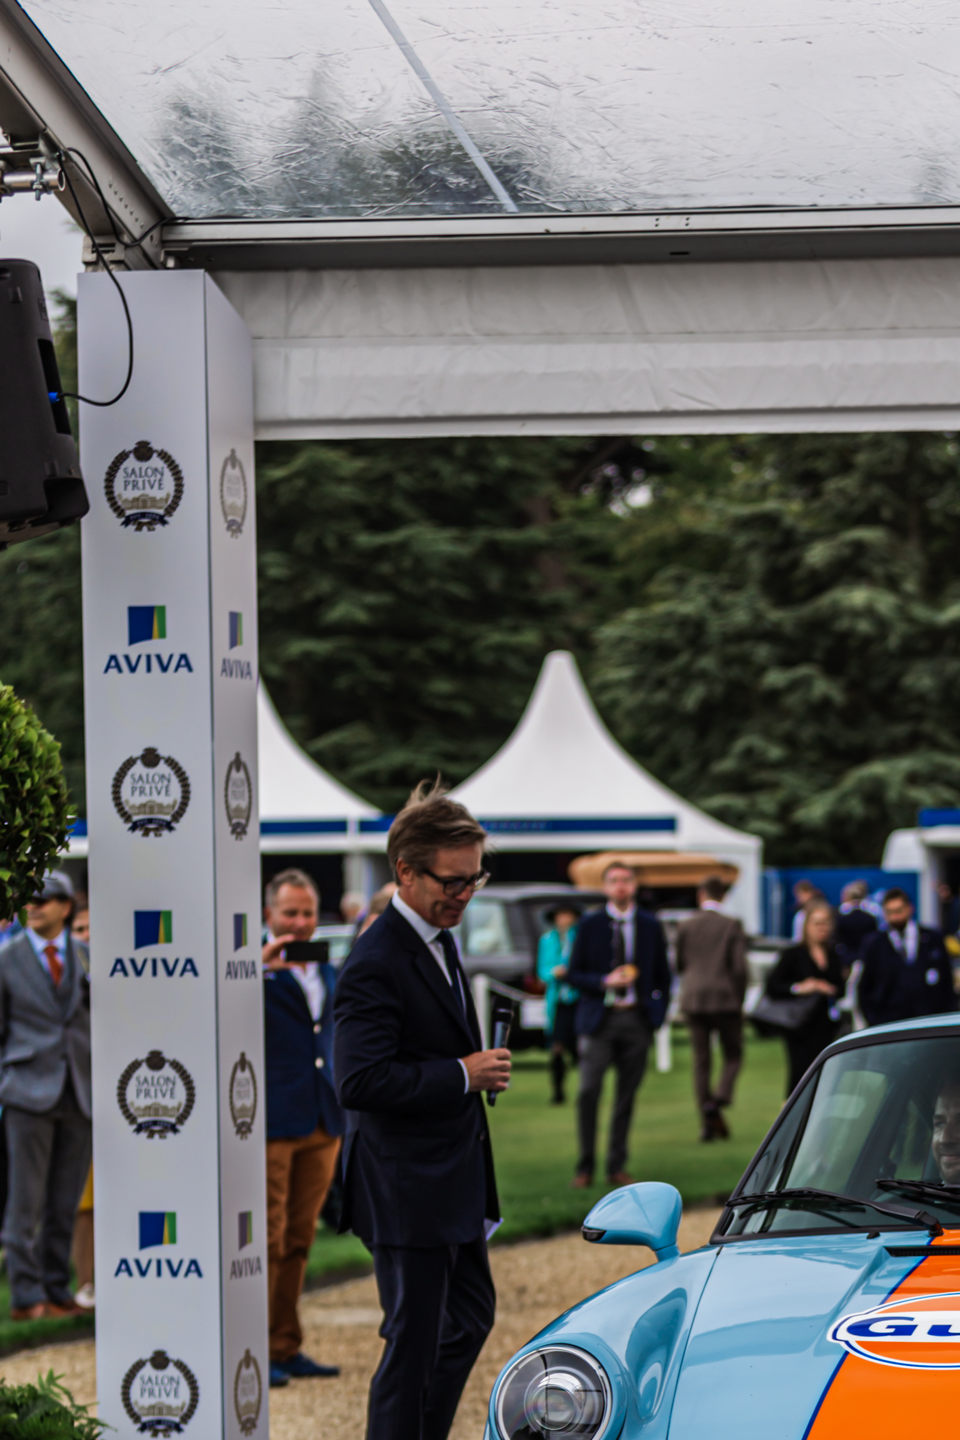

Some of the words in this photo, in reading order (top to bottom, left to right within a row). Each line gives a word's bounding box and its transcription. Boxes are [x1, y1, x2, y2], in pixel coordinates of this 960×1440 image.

[123, 466, 164, 478] SALON
[103, 654, 193, 674] AVIVA
[220, 657, 252, 680] AVIVA
[130, 773, 171, 785] SALON
[109, 957, 199, 978] AVIVA
[225, 960, 257, 980] AVIVA
[135, 1075, 176, 1087] SALON
[114, 1257, 203, 1278] AVIVA
[230, 1255, 262, 1280] AVIVA
[139, 1374, 180, 1387] SALON
